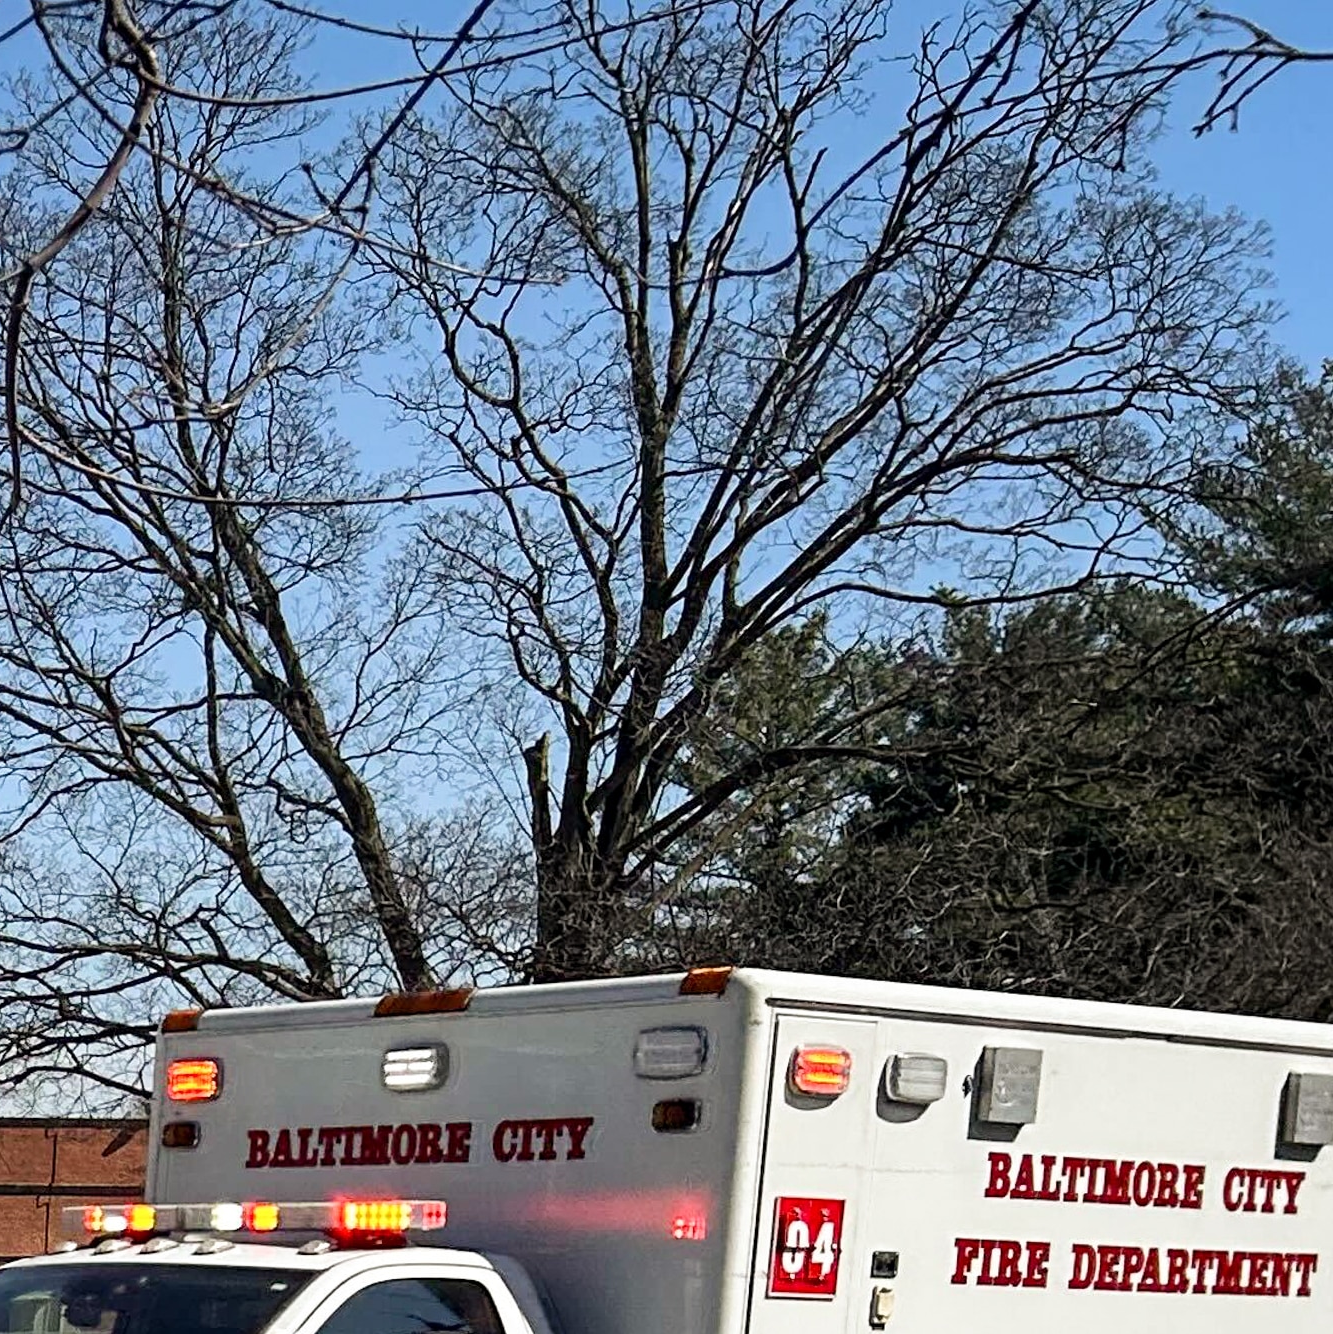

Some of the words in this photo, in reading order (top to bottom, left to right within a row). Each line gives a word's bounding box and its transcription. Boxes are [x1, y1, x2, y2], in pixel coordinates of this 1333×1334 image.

[245, 1122, 472, 1168] BALTIMORE
[493, 1117, 594, 1161] CITY
[984, 1152, 1206, 1210] BALTIMORE
[1223, 1168, 1306, 1214] CITY
[951, 1238, 1050, 1288] FIRE
[1068, 1244, 1318, 1297] DEPARTMENT
